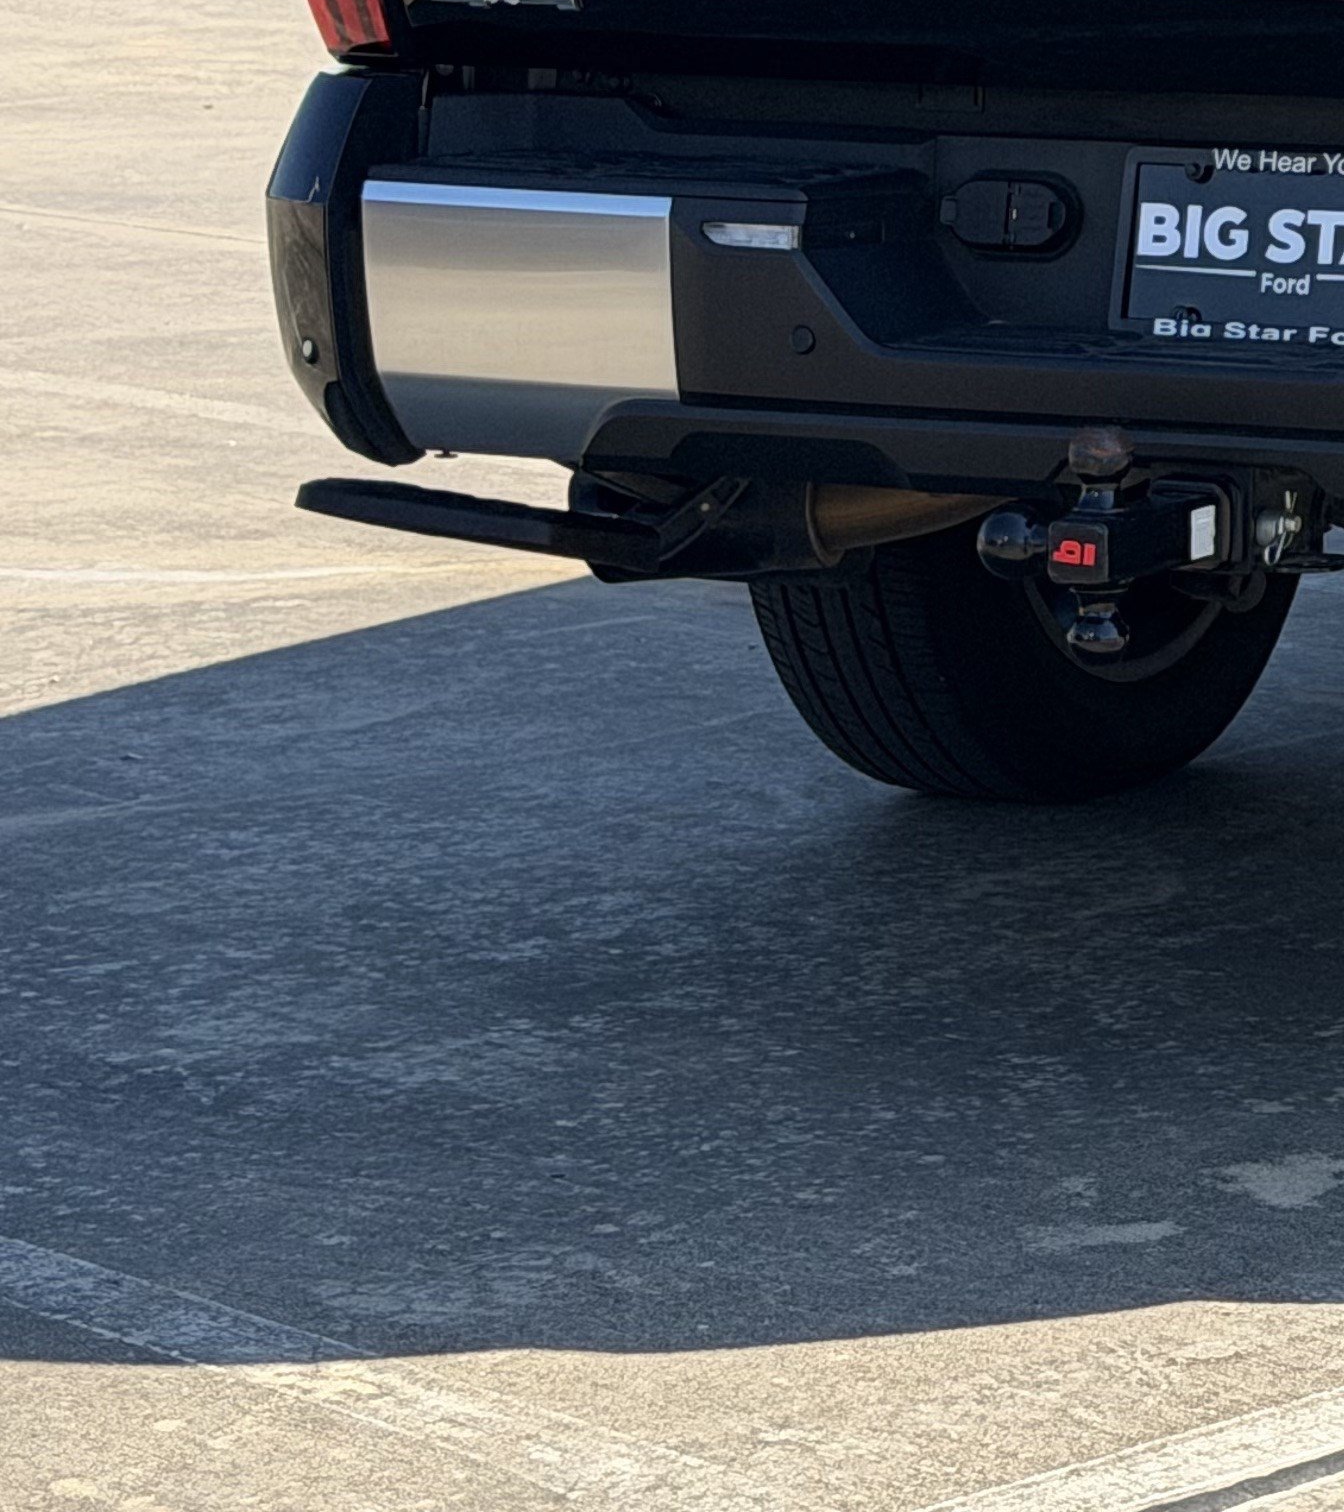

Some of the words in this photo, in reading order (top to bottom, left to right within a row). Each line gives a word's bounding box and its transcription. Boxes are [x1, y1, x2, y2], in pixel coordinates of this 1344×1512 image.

[1212, 147, 1252, 172] We
[1259, 149, 1317, 174] Hear
[1136, 201, 1250, 261] BIG
[1260, 272, 1311, 296] Ford
[1223, 321, 1299, 342] Star
